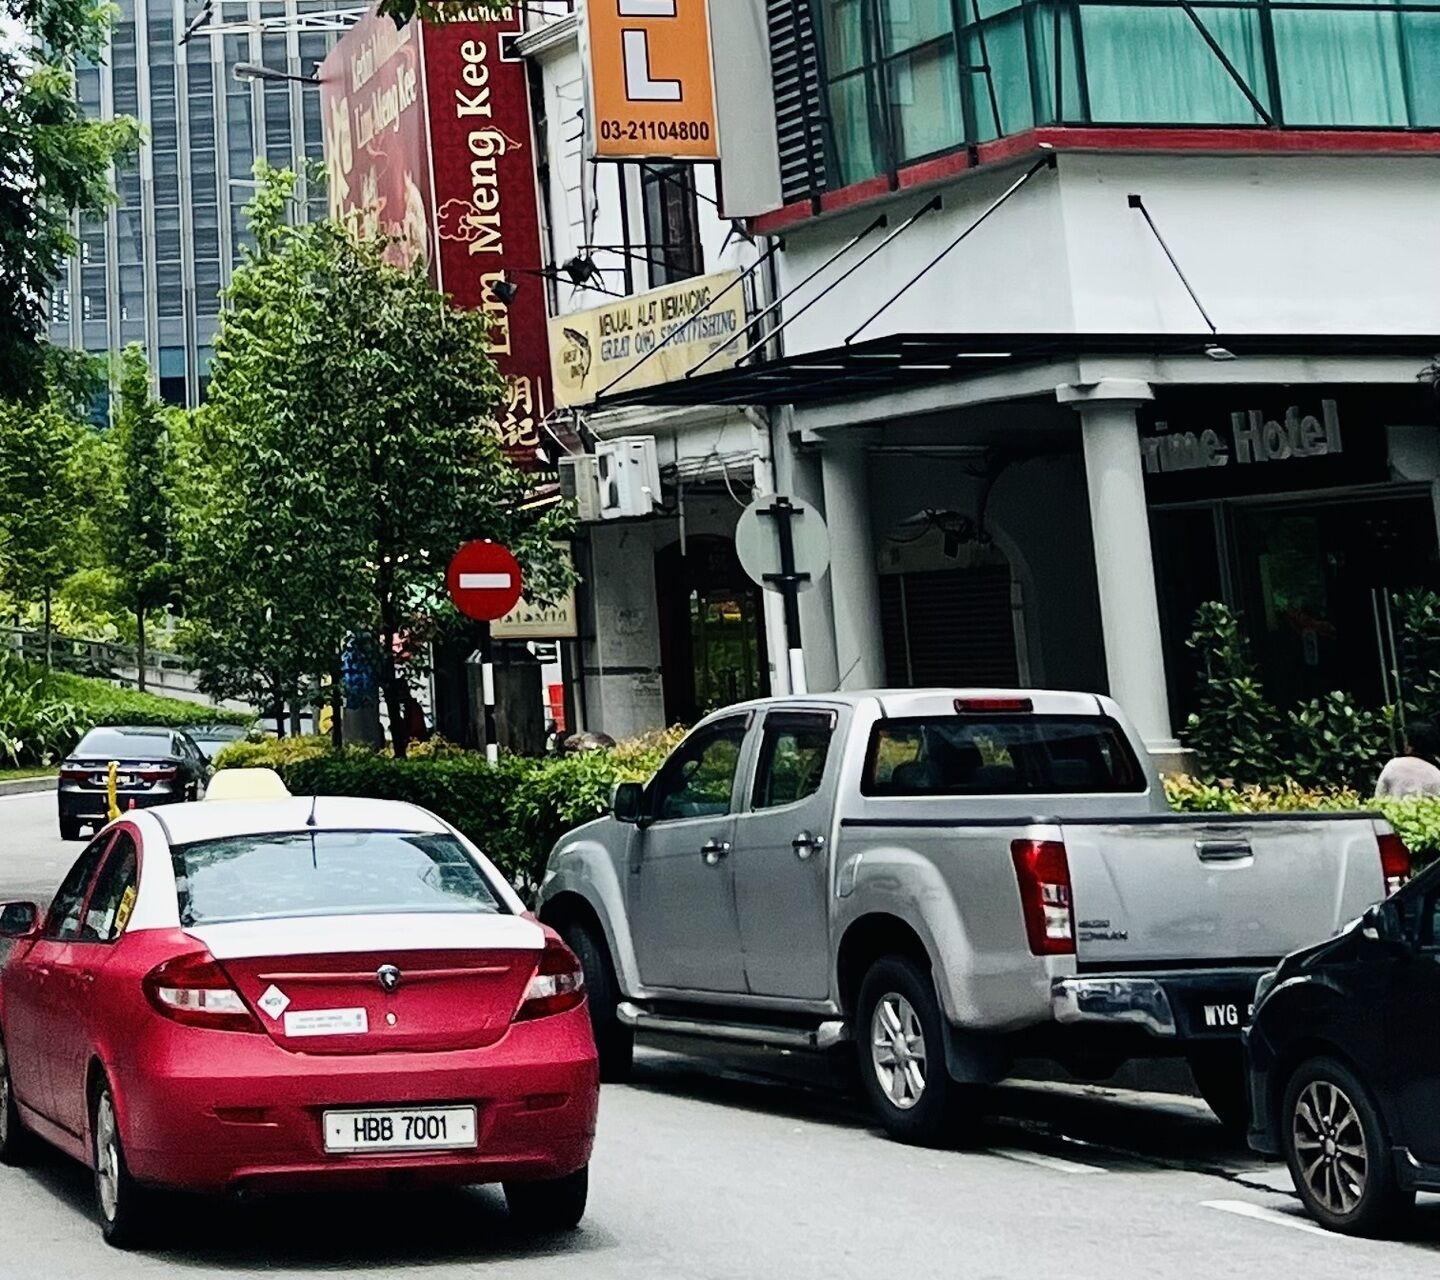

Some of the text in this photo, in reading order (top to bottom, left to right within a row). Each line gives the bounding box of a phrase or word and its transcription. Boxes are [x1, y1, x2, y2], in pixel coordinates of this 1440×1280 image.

[456, 39, 492, 119] Kee
[600, 120, 709, 140] 03-21104800
[467, 128, 506, 255] Meng
[1140, 399, 1344, 474] rime Hotel
[1203, 1003, 1239, 1026] WYG
[353, 1115, 448, 1142] HBB 7001
